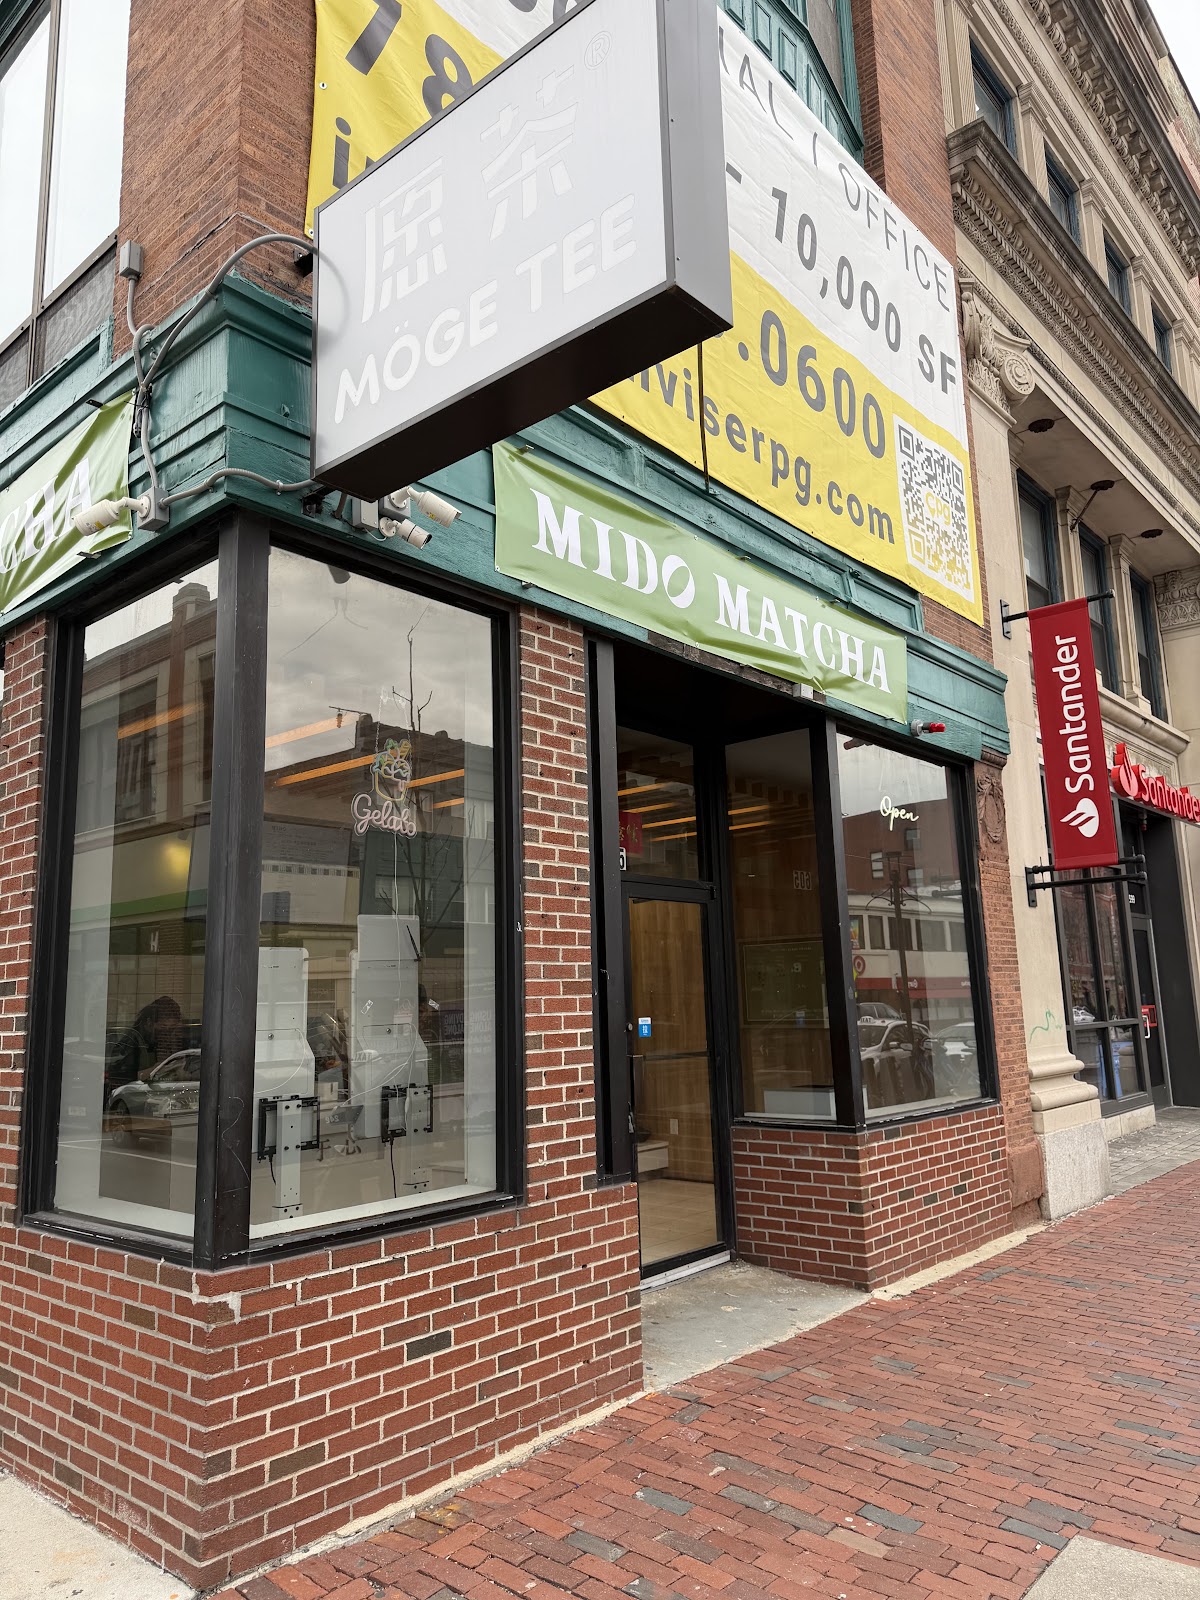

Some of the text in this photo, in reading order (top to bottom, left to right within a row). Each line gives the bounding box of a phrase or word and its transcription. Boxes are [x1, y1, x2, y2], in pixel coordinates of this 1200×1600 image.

[334, 193, 638, 424] MÖGE TEE
[771, 186, 901, 353] 10,000
[917, 334, 957, 398] SF
[838, 162, 951, 313] OFFICE
[713, 310, 887, 458] .0600
[529, 487, 893, 695] MIDO MATCHA
[1052, 635, 1095, 793] Santander
[353, 793, 417, 836] Gelato
[880, 795, 919, 831] Open
[1138, 763, 1200, 822] Santande
